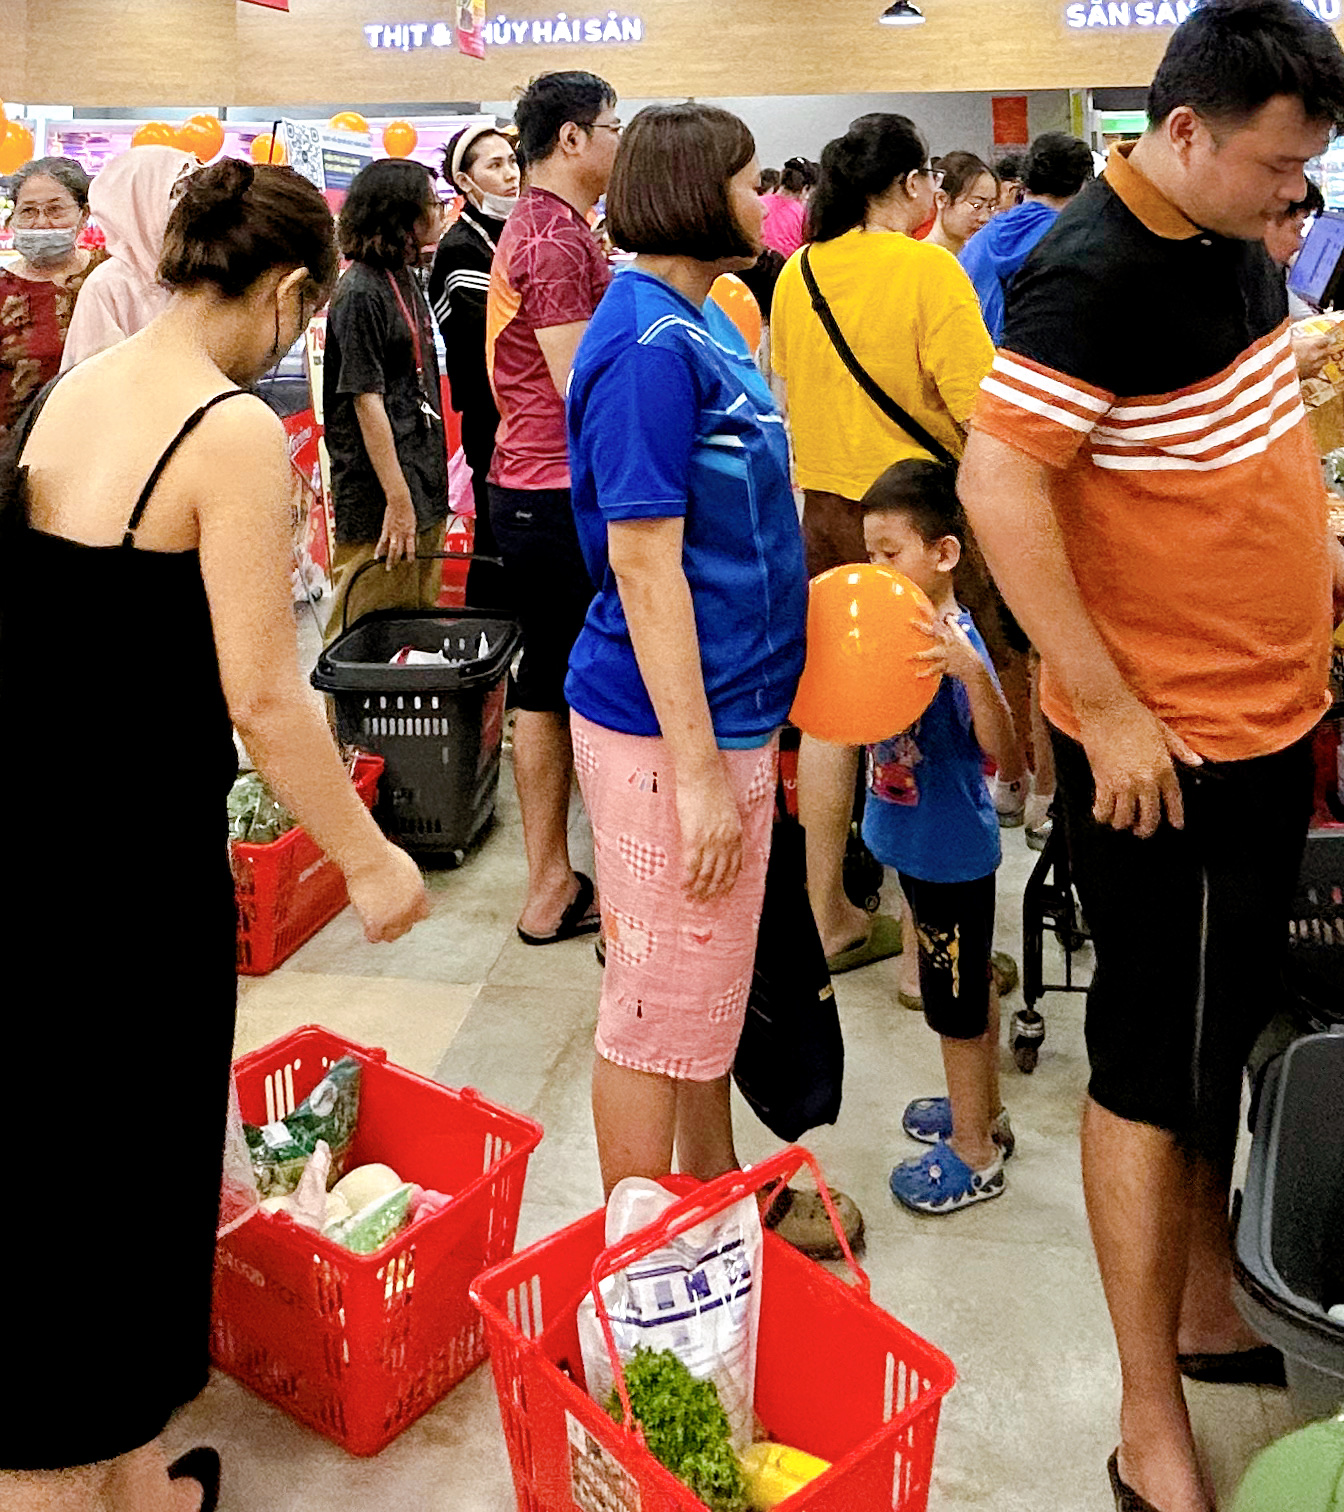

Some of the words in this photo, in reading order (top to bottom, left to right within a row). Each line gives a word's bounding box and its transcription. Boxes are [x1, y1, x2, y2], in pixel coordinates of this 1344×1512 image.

[364, 23, 427, 52] THỊT
[432, 22, 452, 47] &
[481, 14, 528, 44] HỦY
[532, 12, 580, 44] HẢI
[584, 10, 642, 42] SẢN
